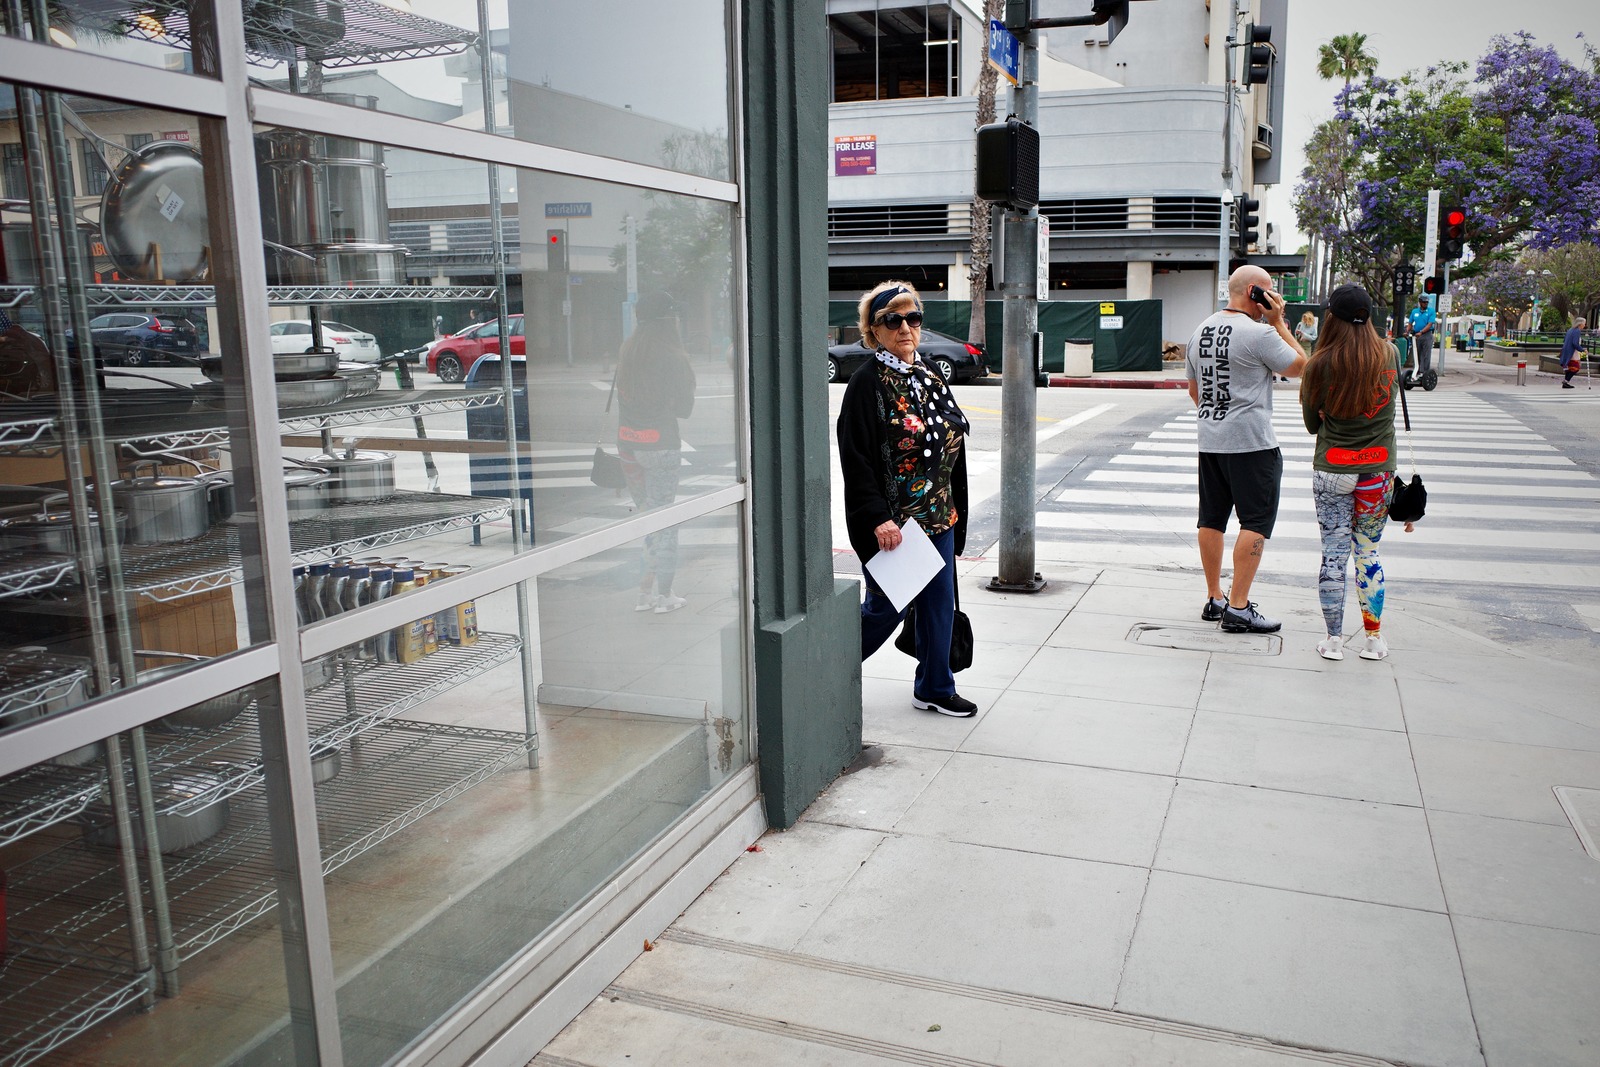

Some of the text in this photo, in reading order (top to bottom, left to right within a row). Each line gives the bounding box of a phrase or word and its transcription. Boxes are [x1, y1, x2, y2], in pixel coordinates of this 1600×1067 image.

[836, 141, 875, 151] FOR LEASE
[1198, 326, 1216, 419] STRIVE FOR
[1213, 324, 1233, 421] GREATNESS
[1351, 450, 1382, 462] CREW
